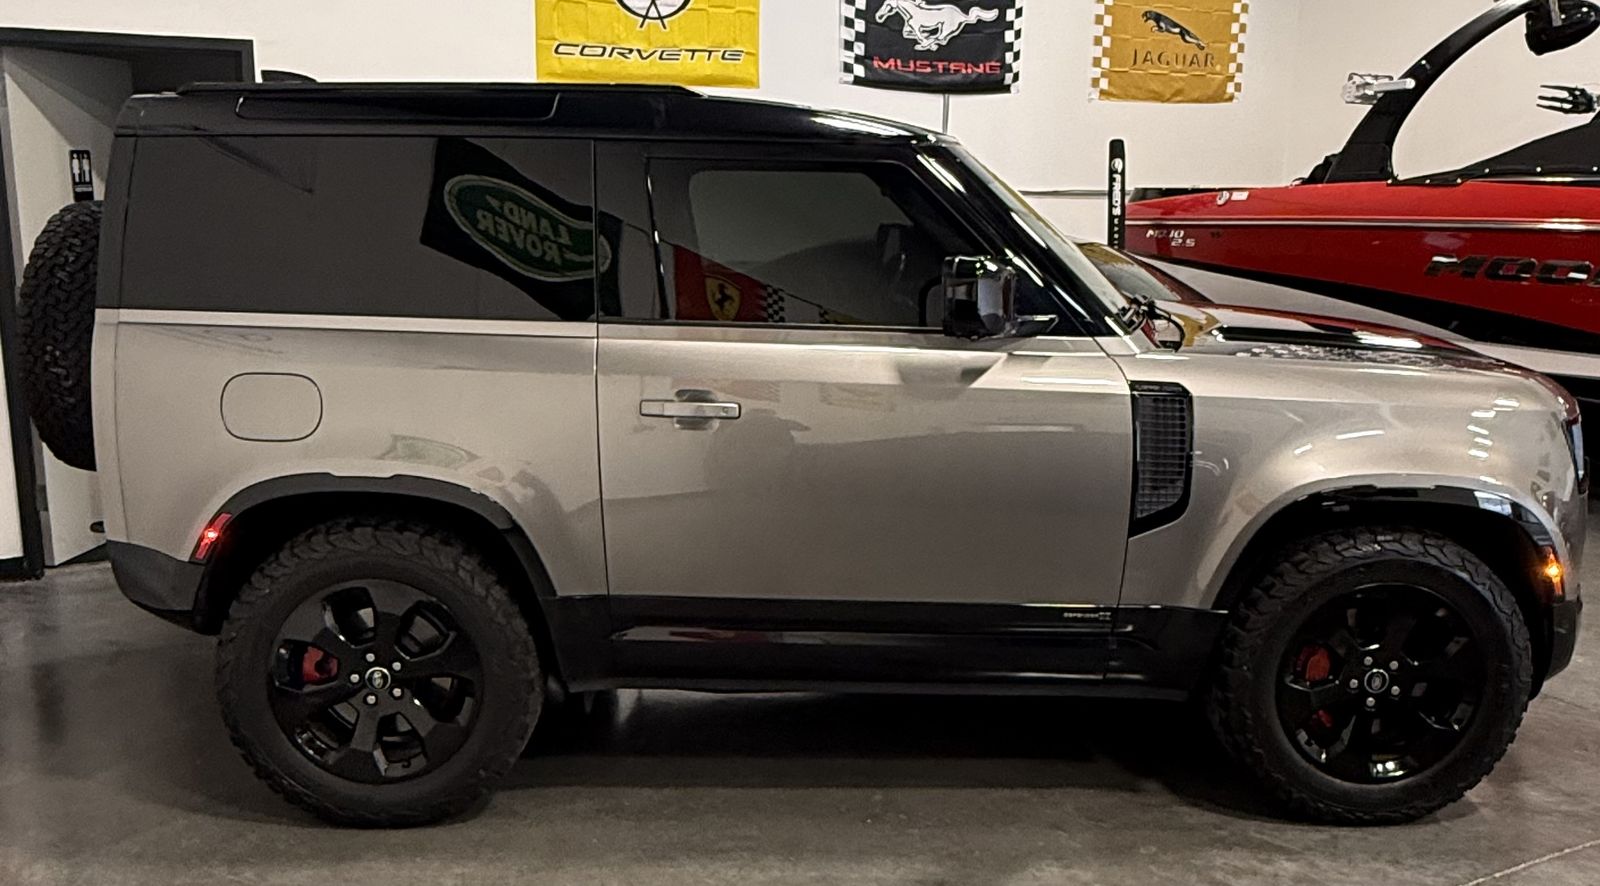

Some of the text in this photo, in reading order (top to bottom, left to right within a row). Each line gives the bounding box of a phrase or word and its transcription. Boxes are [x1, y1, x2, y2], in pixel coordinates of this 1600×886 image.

[554, 43, 744, 61] CORVETTE
[1132, 48, 1216, 68] JAGUAR
[872, 56, 1001, 75] MUSTANG
[1170, 238, 1196, 247] 2.5
[1424, 254, 1600, 287] MOO
